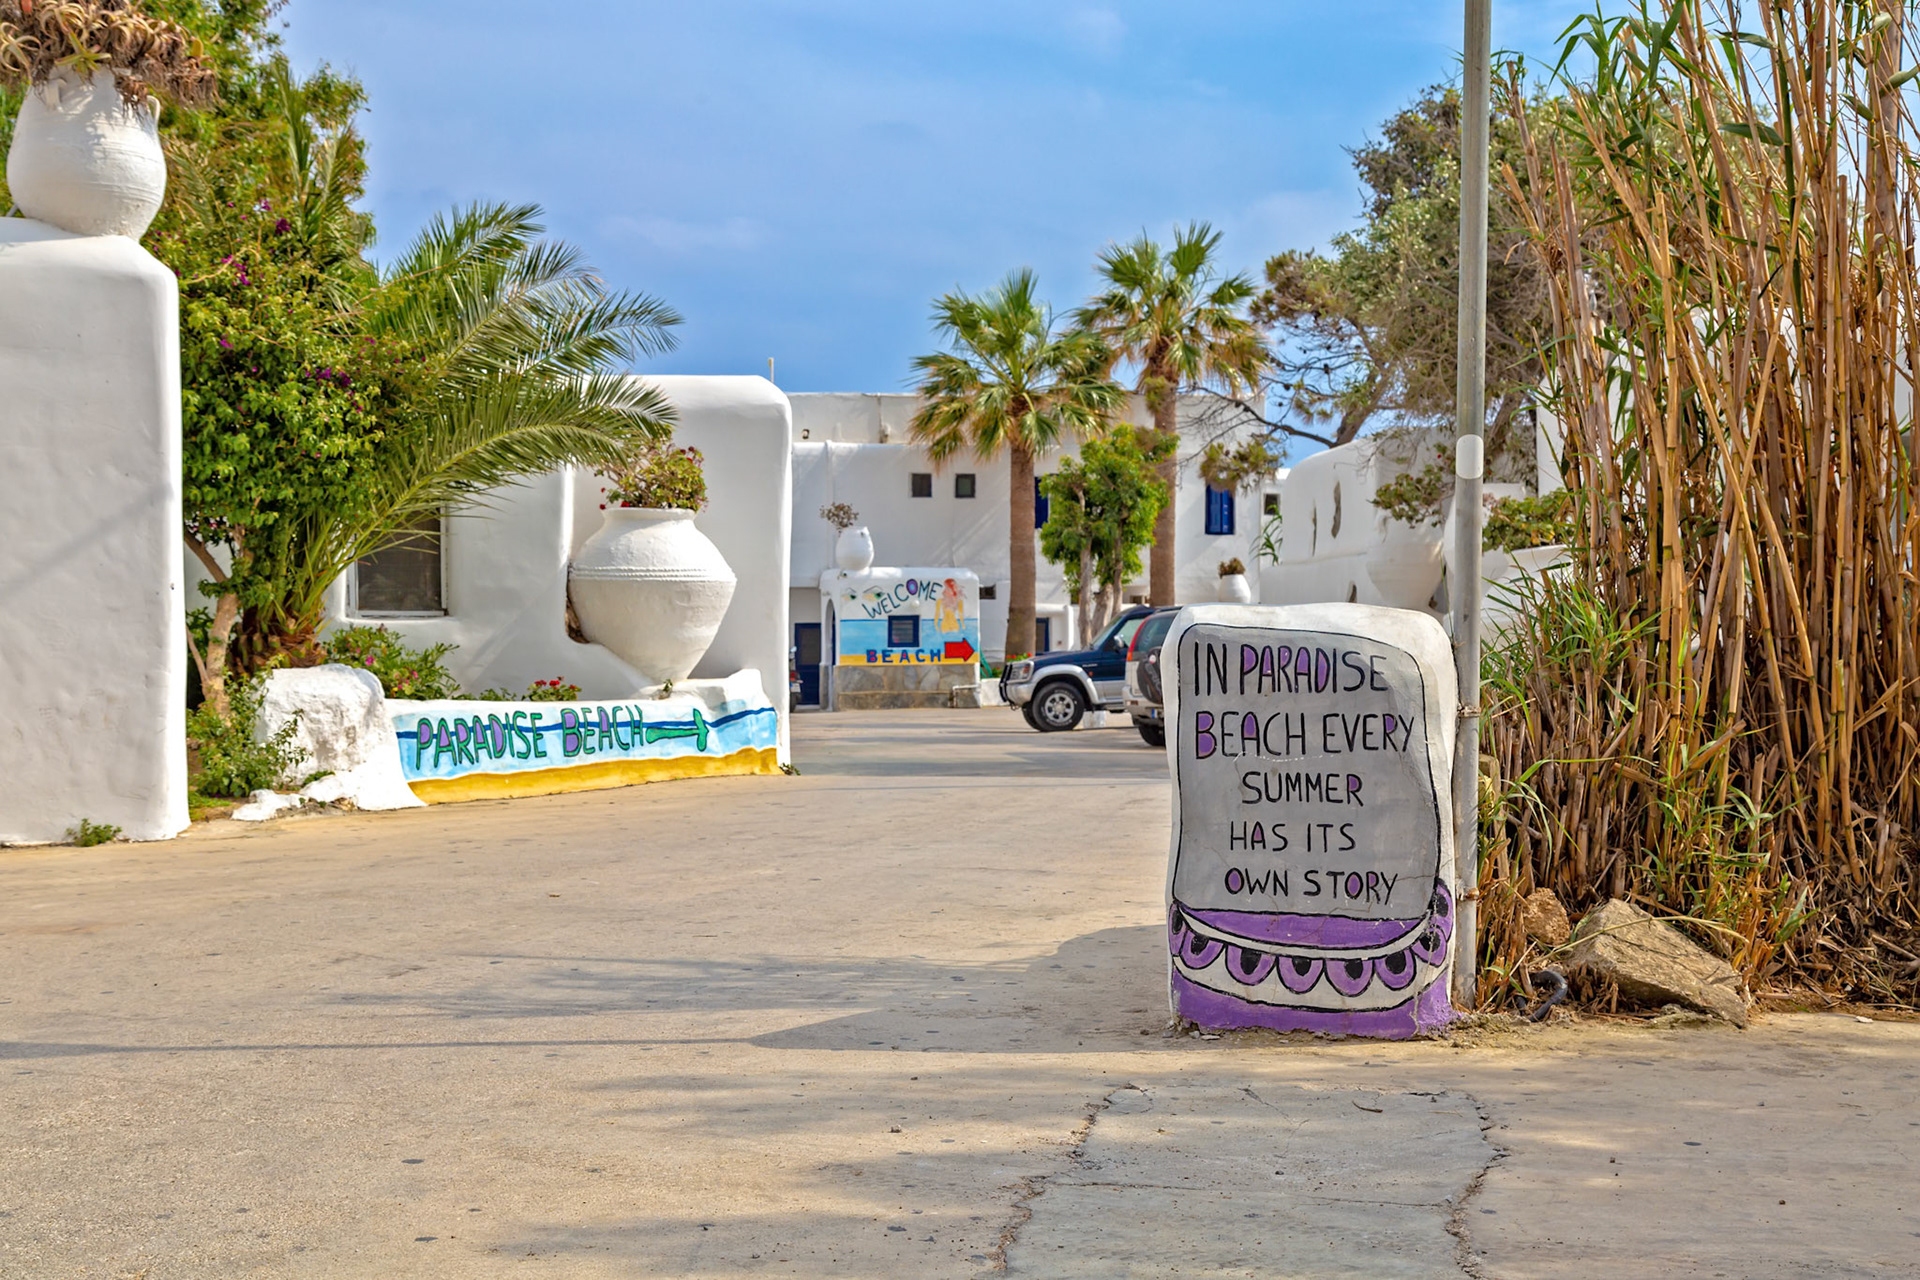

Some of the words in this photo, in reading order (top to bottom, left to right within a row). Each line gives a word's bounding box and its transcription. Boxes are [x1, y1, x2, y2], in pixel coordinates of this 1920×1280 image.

[862, 578, 943, 618] WELCOME
[866, 649, 941, 663] BEACH
[1194, 641, 1227, 696] IN
[1240, 644, 1389, 696] PARADISE
[416, 711, 547, 770] PARADISE
[560, 704, 644, 757] BEACH
[1195, 711, 1306, 759] BEACH
[1323, 713, 1415, 753] EVERY
[1242, 771, 1364, 807] SUMMER
[1230, 821, 1288, 852] HAS
[1307, 823, 1356, 852] ITS
[1224, 869, 1288, 897] OWN
[1303, 871, 1398, 905] STORY
